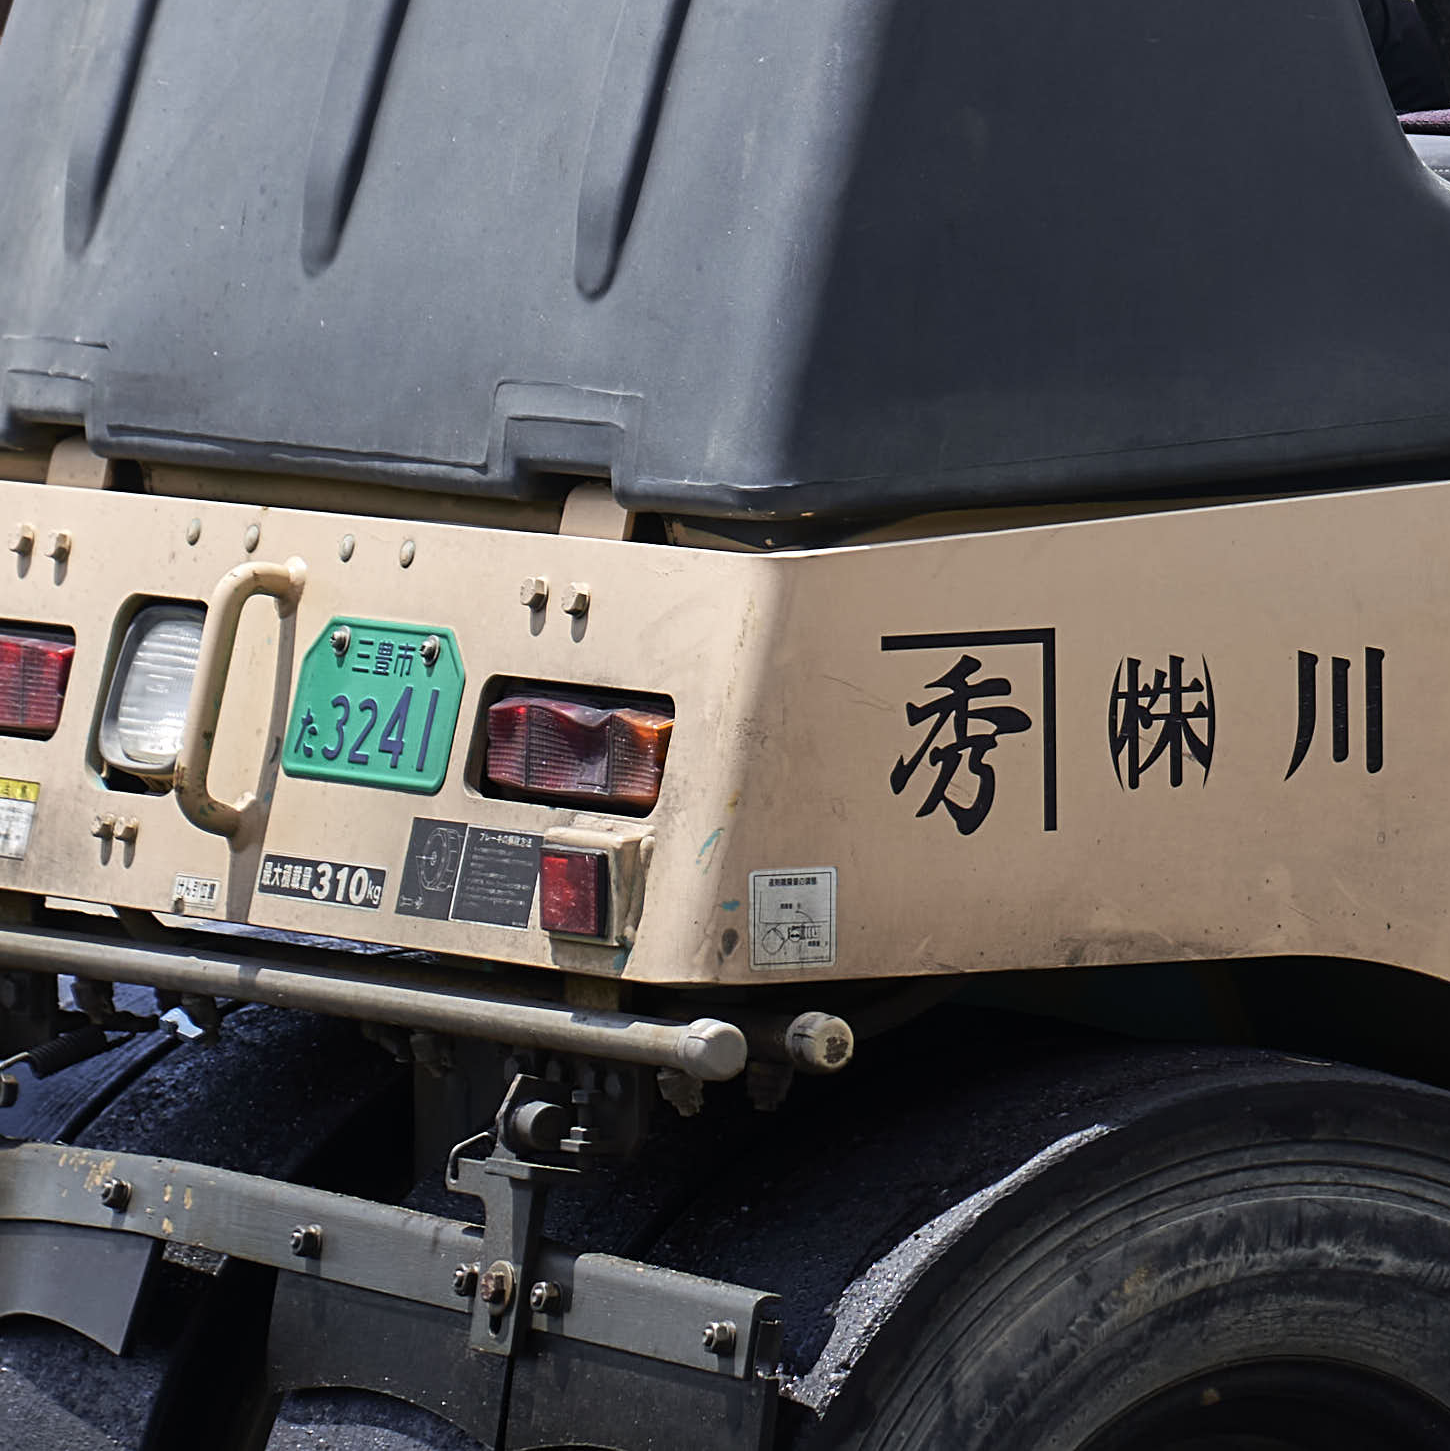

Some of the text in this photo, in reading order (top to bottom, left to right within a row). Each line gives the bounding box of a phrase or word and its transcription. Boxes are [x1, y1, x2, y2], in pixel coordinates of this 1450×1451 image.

[351, 640, 417, 677] 三豊市
[321, 685, 440, 772] 3241
[889, 654, 1033, 836] 秀
